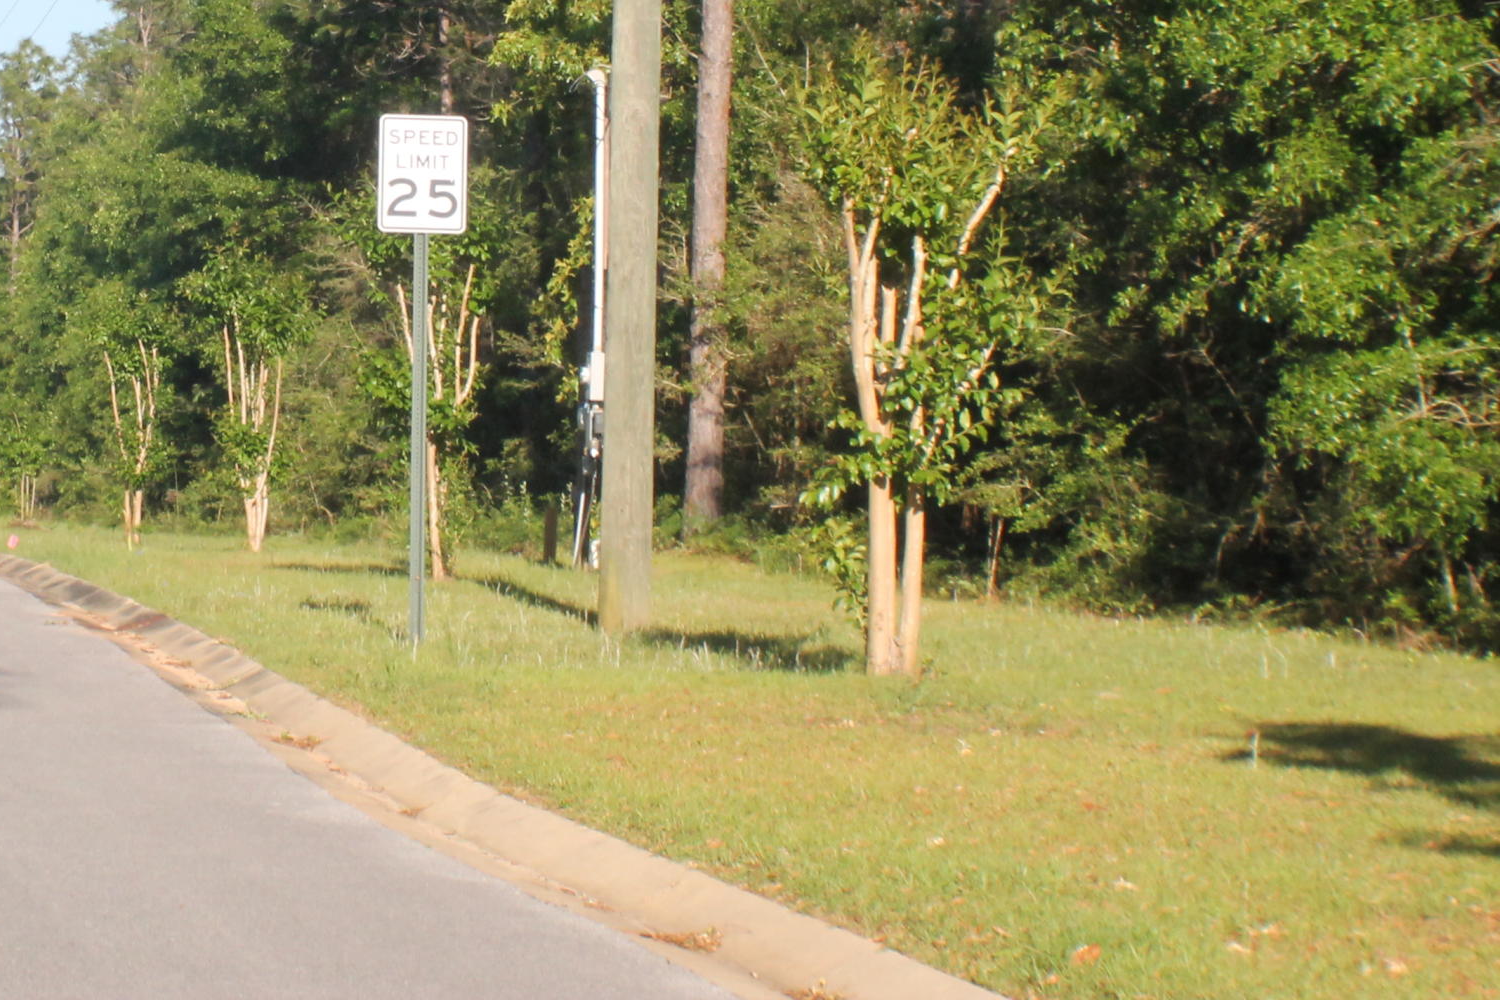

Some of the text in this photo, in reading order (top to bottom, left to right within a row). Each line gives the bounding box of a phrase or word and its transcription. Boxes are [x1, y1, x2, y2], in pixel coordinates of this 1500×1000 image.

[390, 130, 458, 146] SPEED
[396, 154, 449, 169] LIMIT
[387, 178, 457, 218] 25
